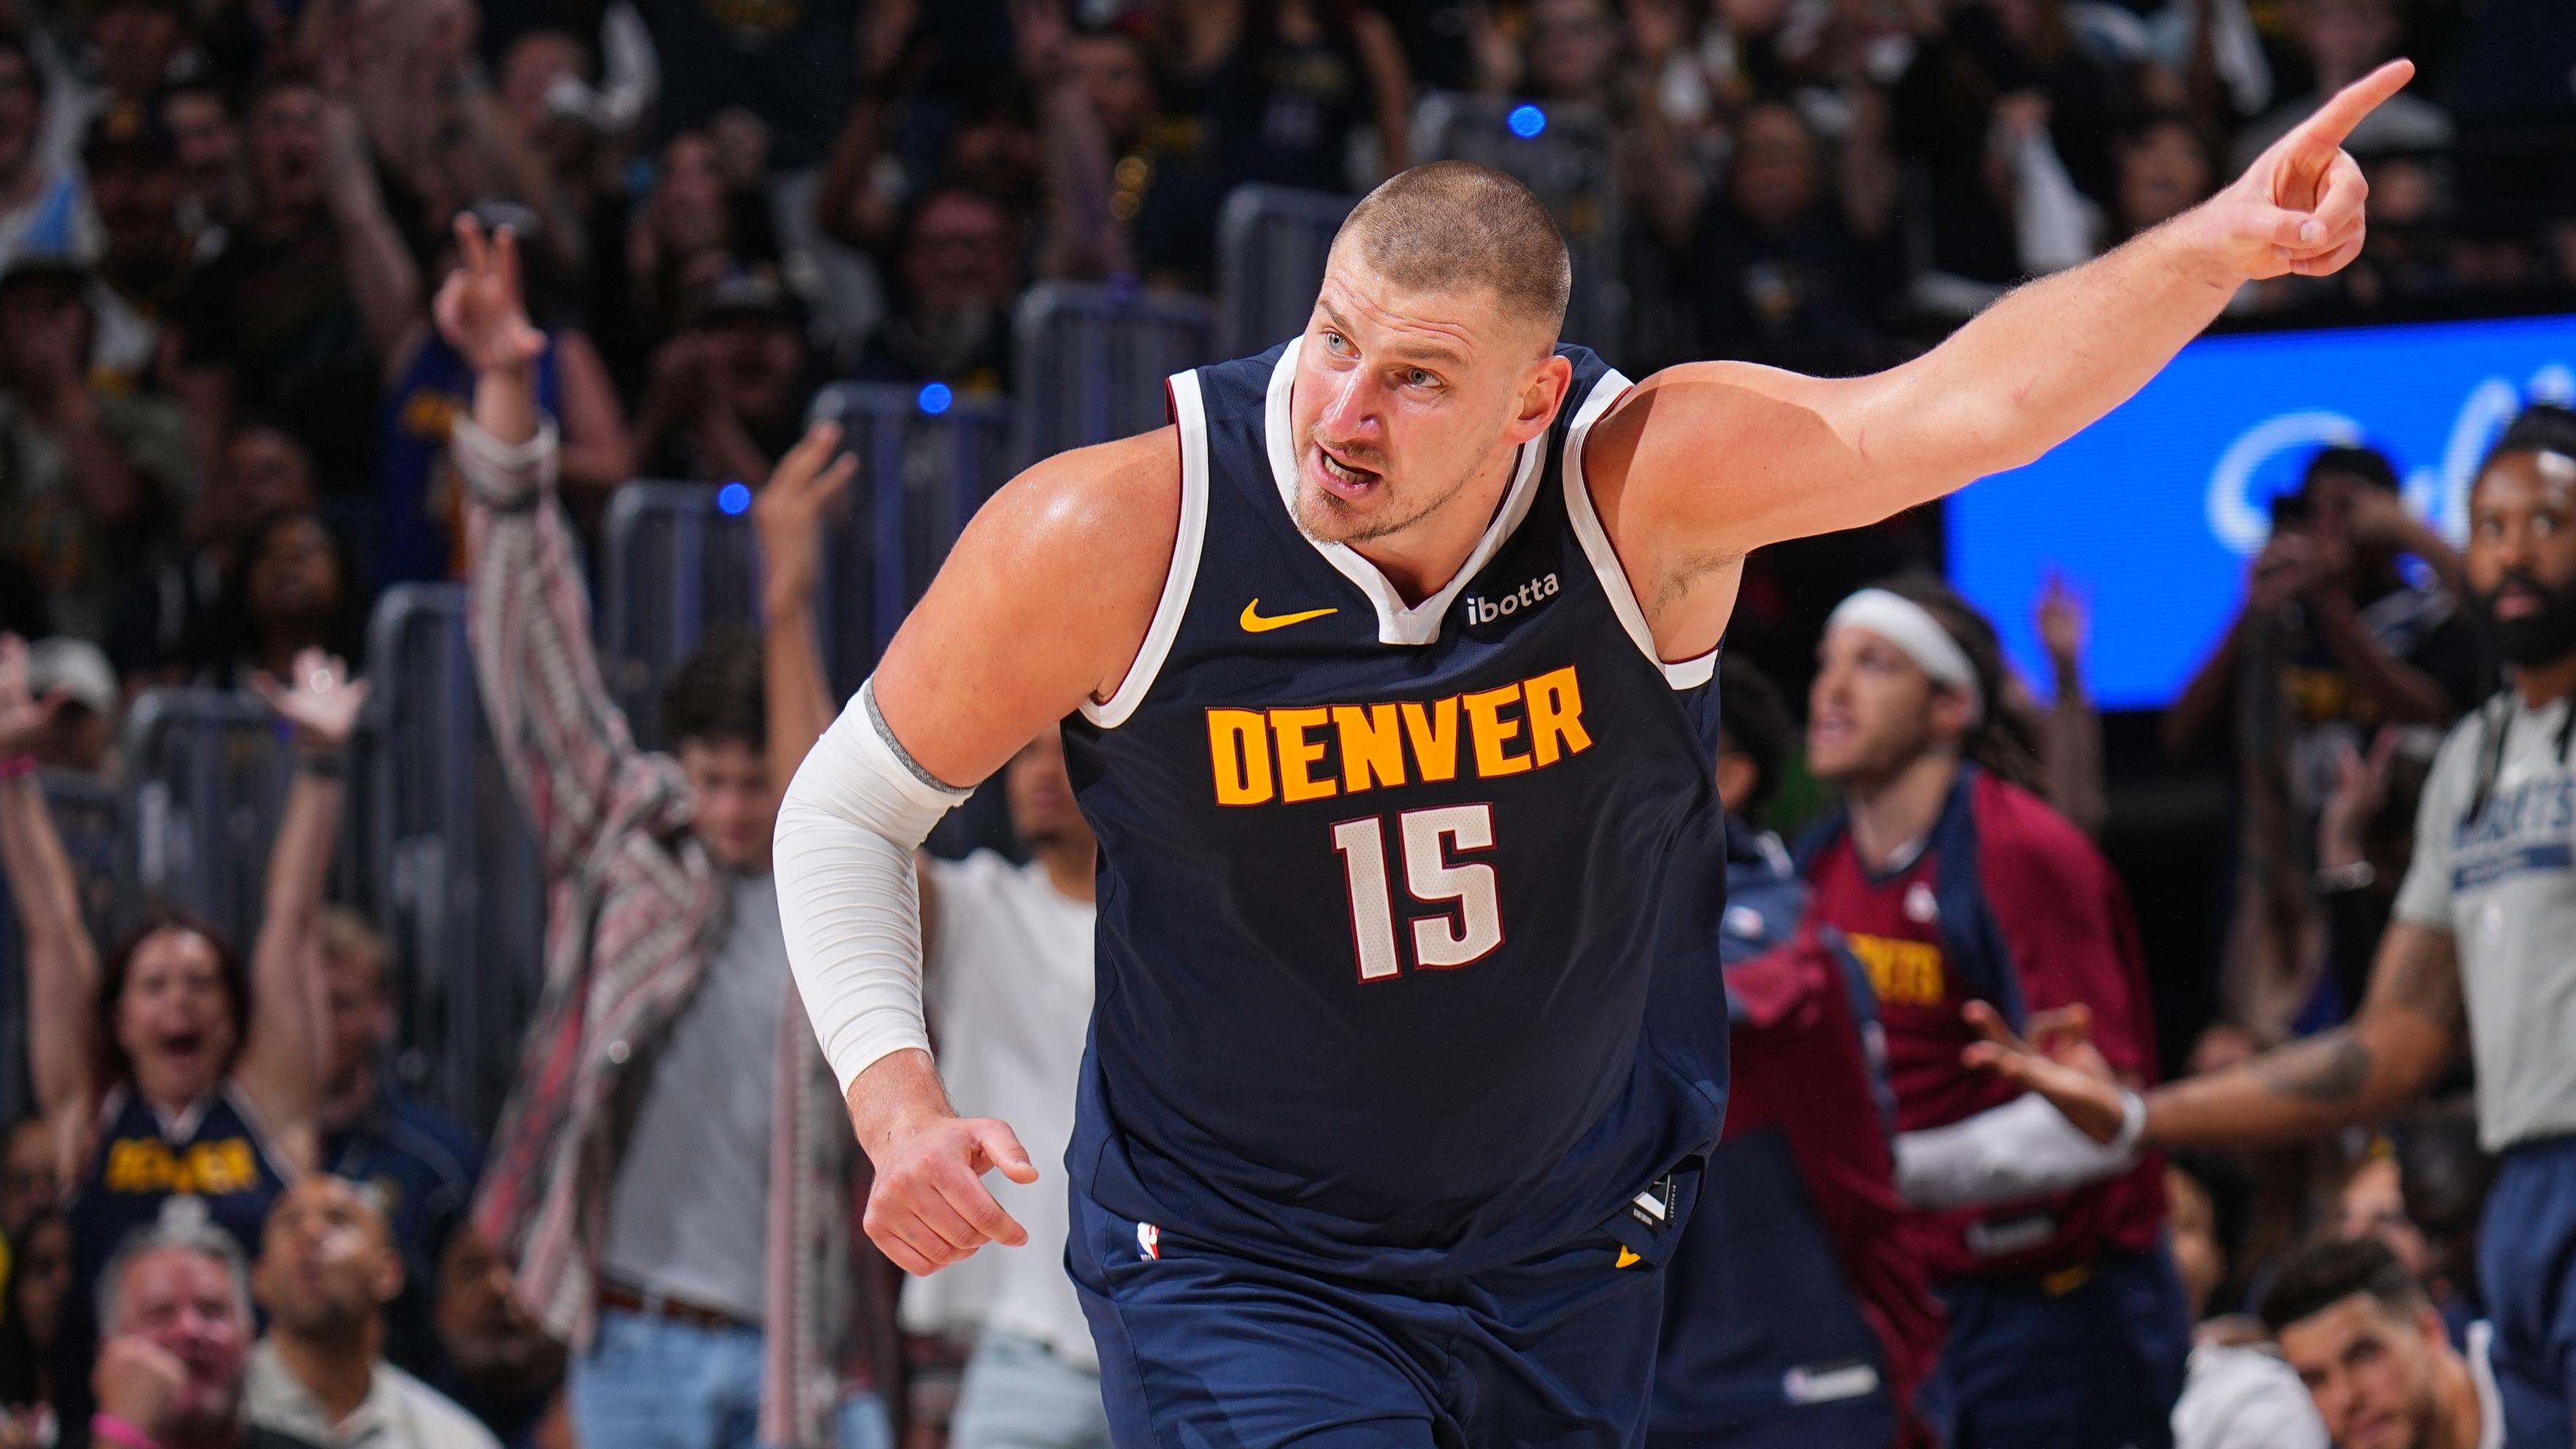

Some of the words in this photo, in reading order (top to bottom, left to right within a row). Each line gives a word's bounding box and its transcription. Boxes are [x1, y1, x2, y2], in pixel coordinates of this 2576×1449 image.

[1467, 573, 1560, 626] ibotta
[1205, 662, 1595, 806] DENVER
[1330, 801, 1506, 984] 15
